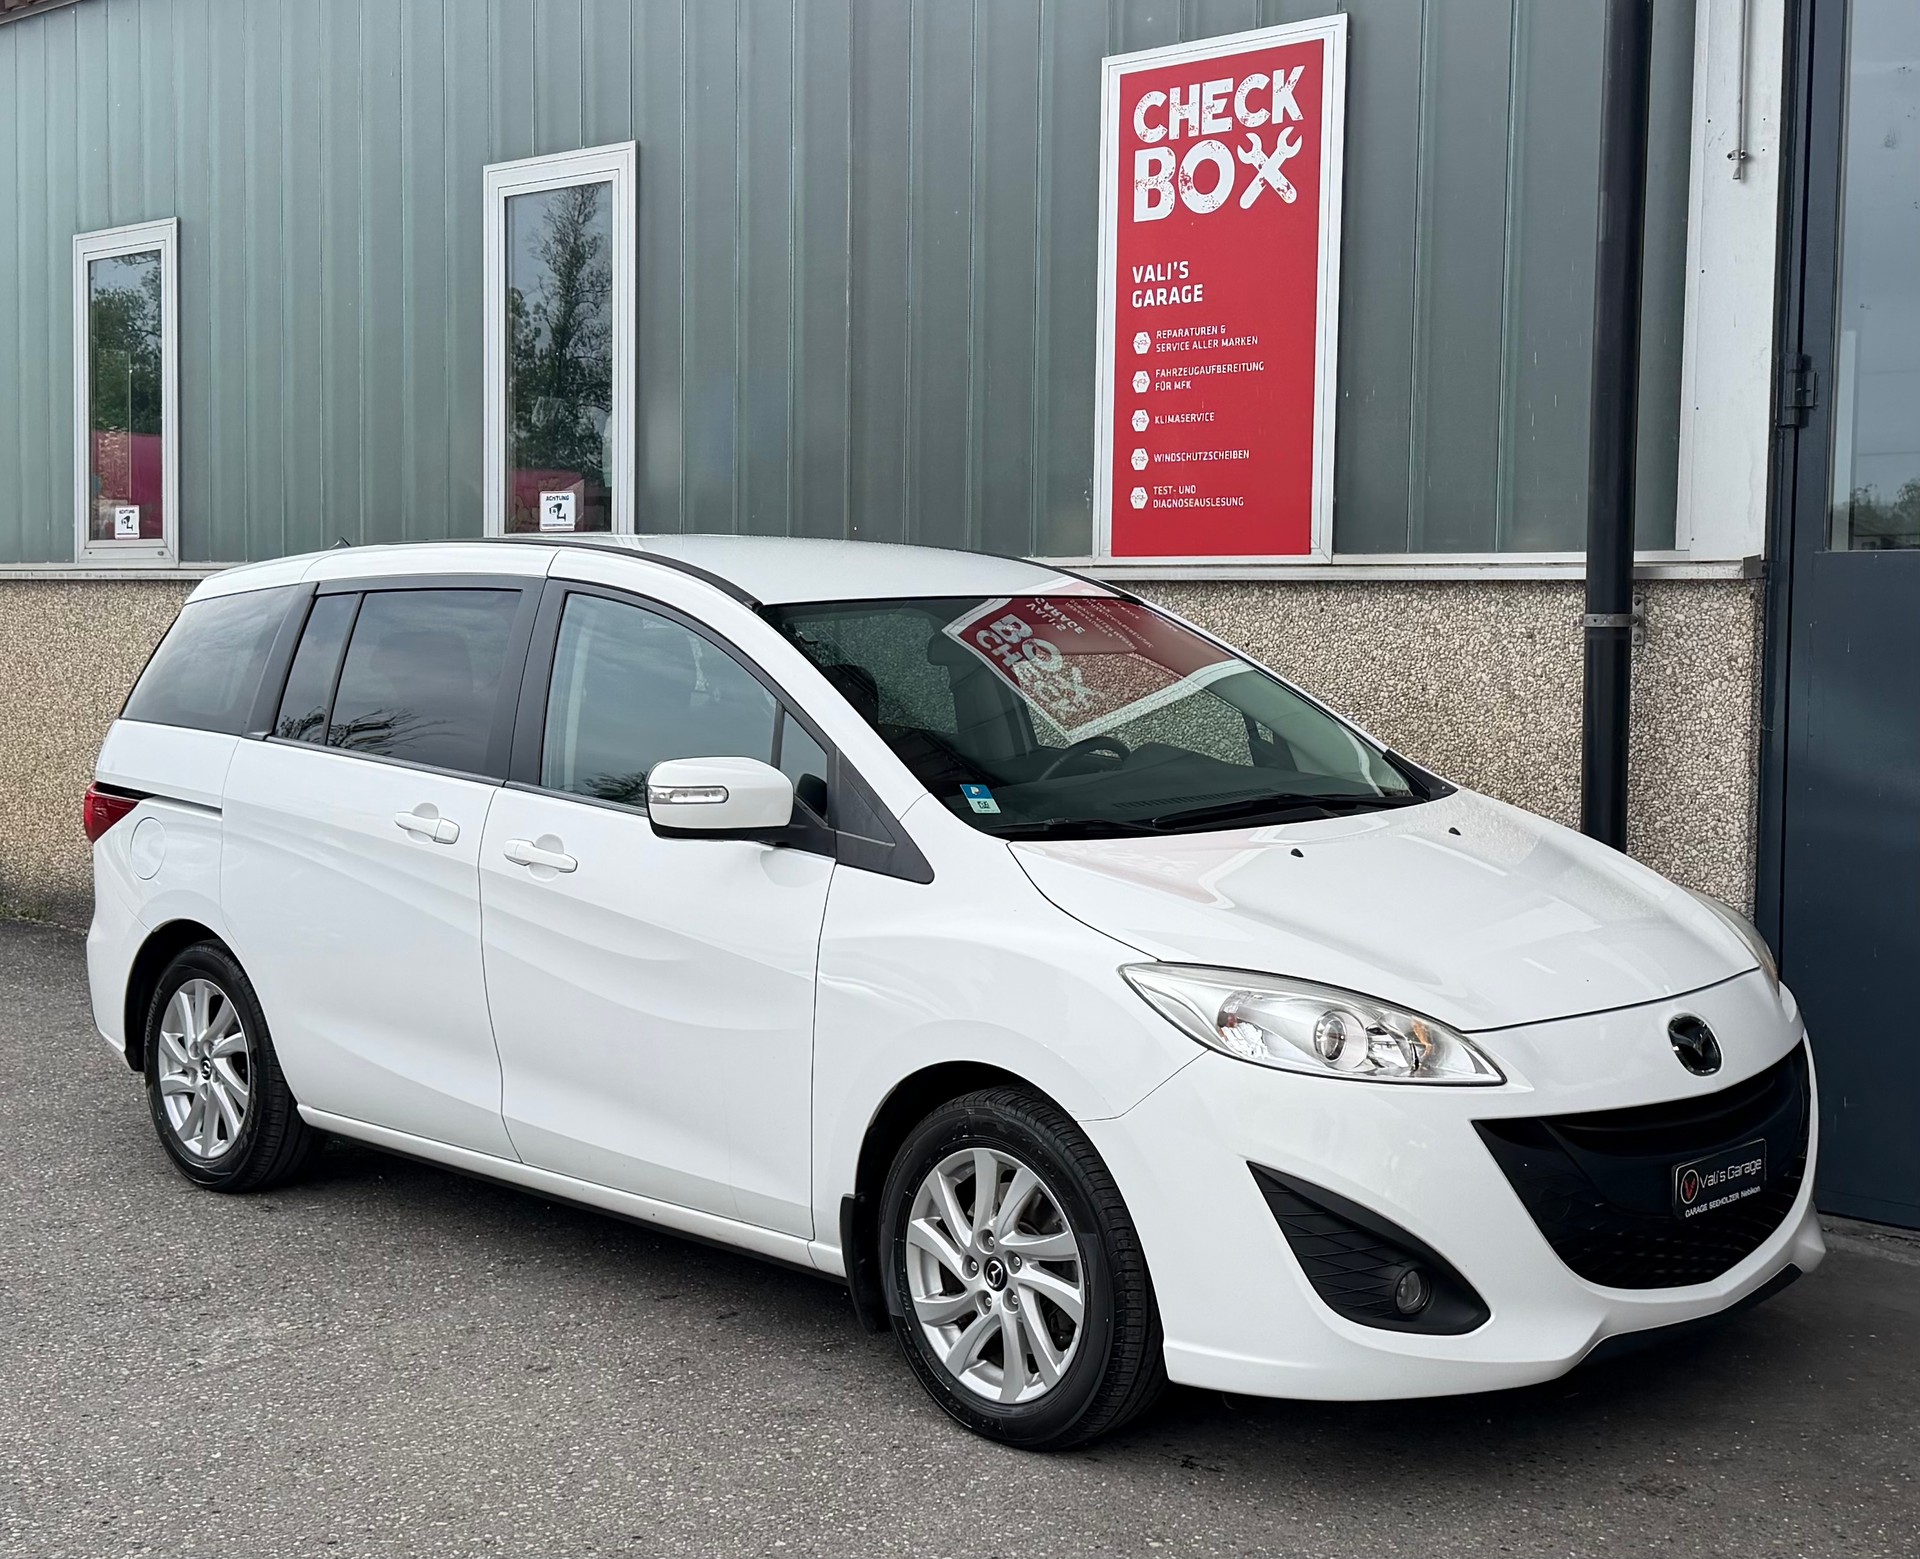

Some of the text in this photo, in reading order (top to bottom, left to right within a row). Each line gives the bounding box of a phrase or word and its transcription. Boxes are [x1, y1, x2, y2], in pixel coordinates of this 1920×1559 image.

[1133, 65, 1305, 143] CHECK
[1132, 261, 1189, 283] VALI'S
[1132, 284, 1203, 308] GARAGE
[1156, 325, 1218, 339] REPARATUREN
[1156, 336, 1258, 353] SERVICE ALLER MARKEN
[1155, 361, 1265, 378] FAHRZEUGAUFBEREITUNG
[1155, 380, 1192, 391] FÜR MFK
[1154, 412, 1215, 425] KLIMASERVICE
[1153, 450, 1250, 463] WINDSCHUTZSCHEIBEN
[1153, 484, 1196, 495] TEST- UND
[1153, 497, 1244, 508] DIAGNOSEAUSLESUNG
[1727, 1158, 1762, 1180] Garage
[1685, 1203, 1708, 1218] GARAGE
